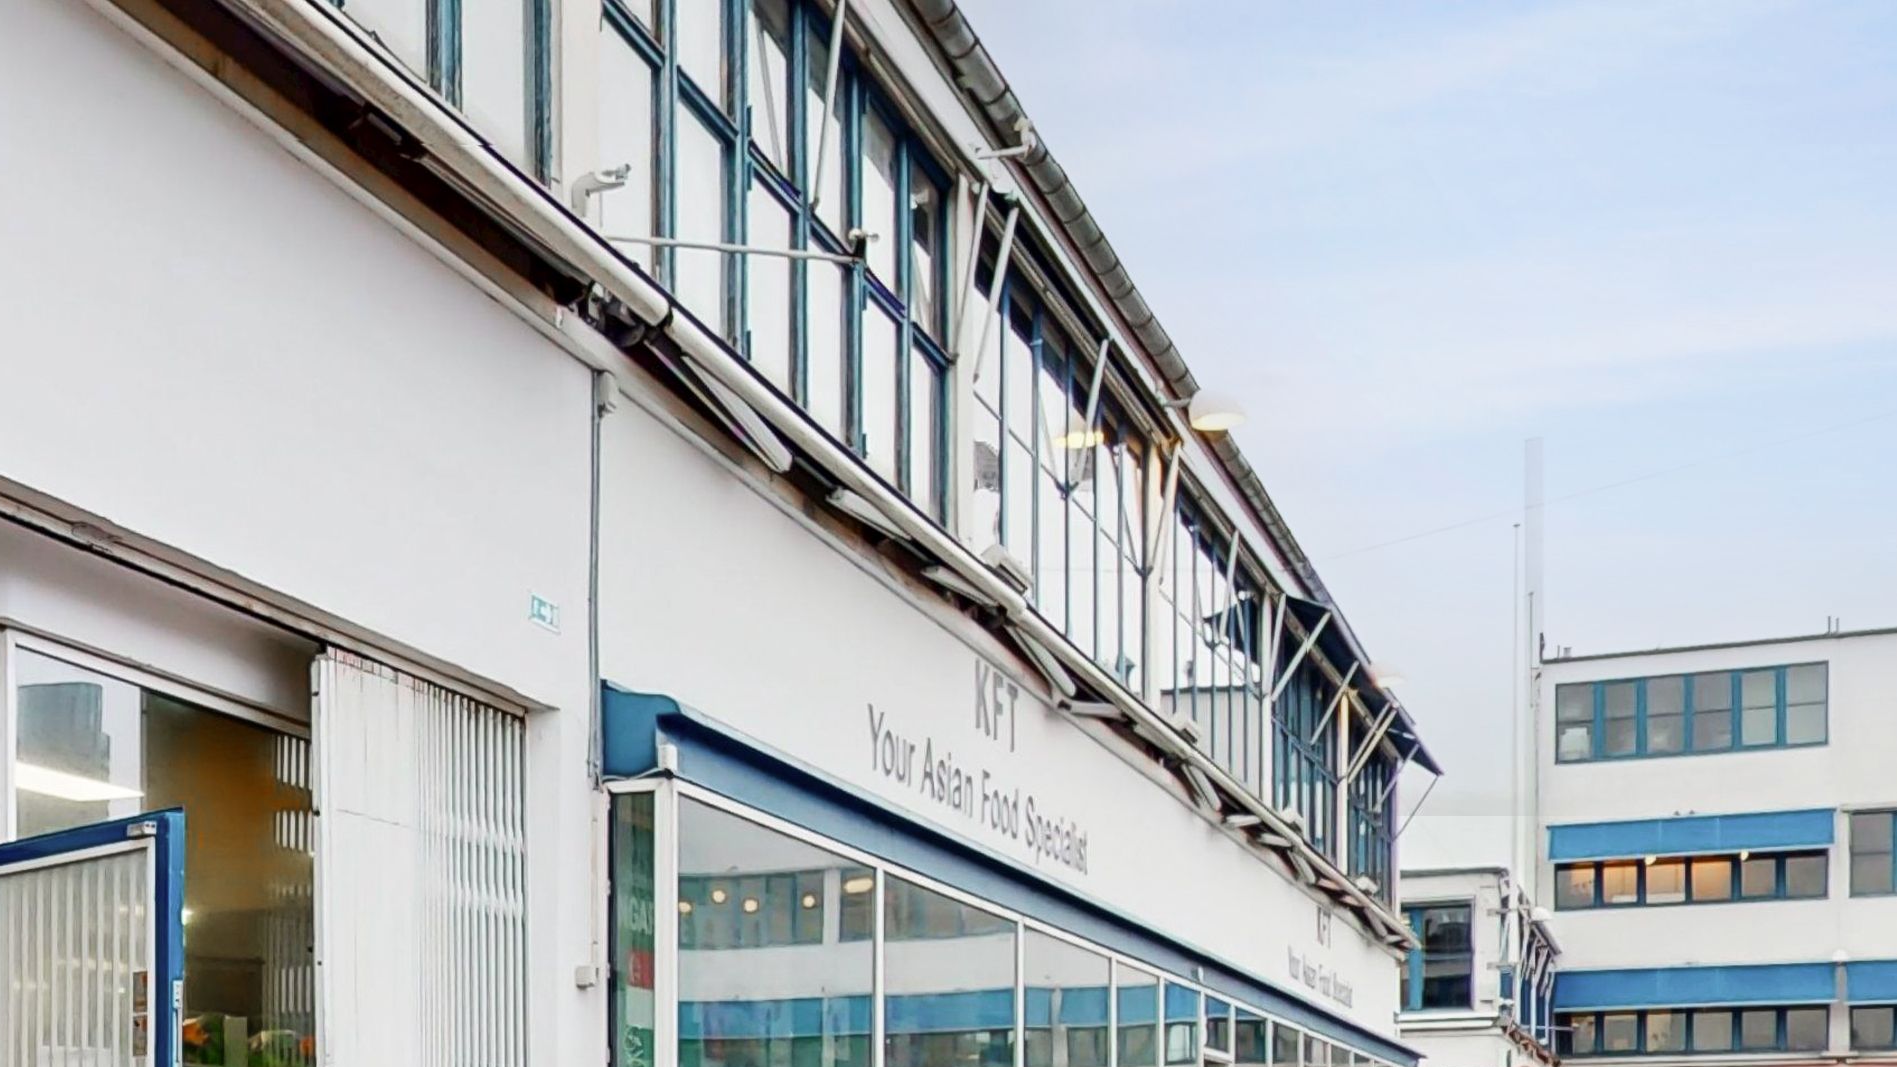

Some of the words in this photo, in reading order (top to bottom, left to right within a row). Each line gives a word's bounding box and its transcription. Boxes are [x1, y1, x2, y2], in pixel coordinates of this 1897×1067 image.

[974, 656, 1019, 753] KFT
[866, 702, 916, 788] Your
[919, 737, 974, 819] Asian
[980, 768, 1019, 840] Food
[1024, 794, 1089, 876] Specialist
